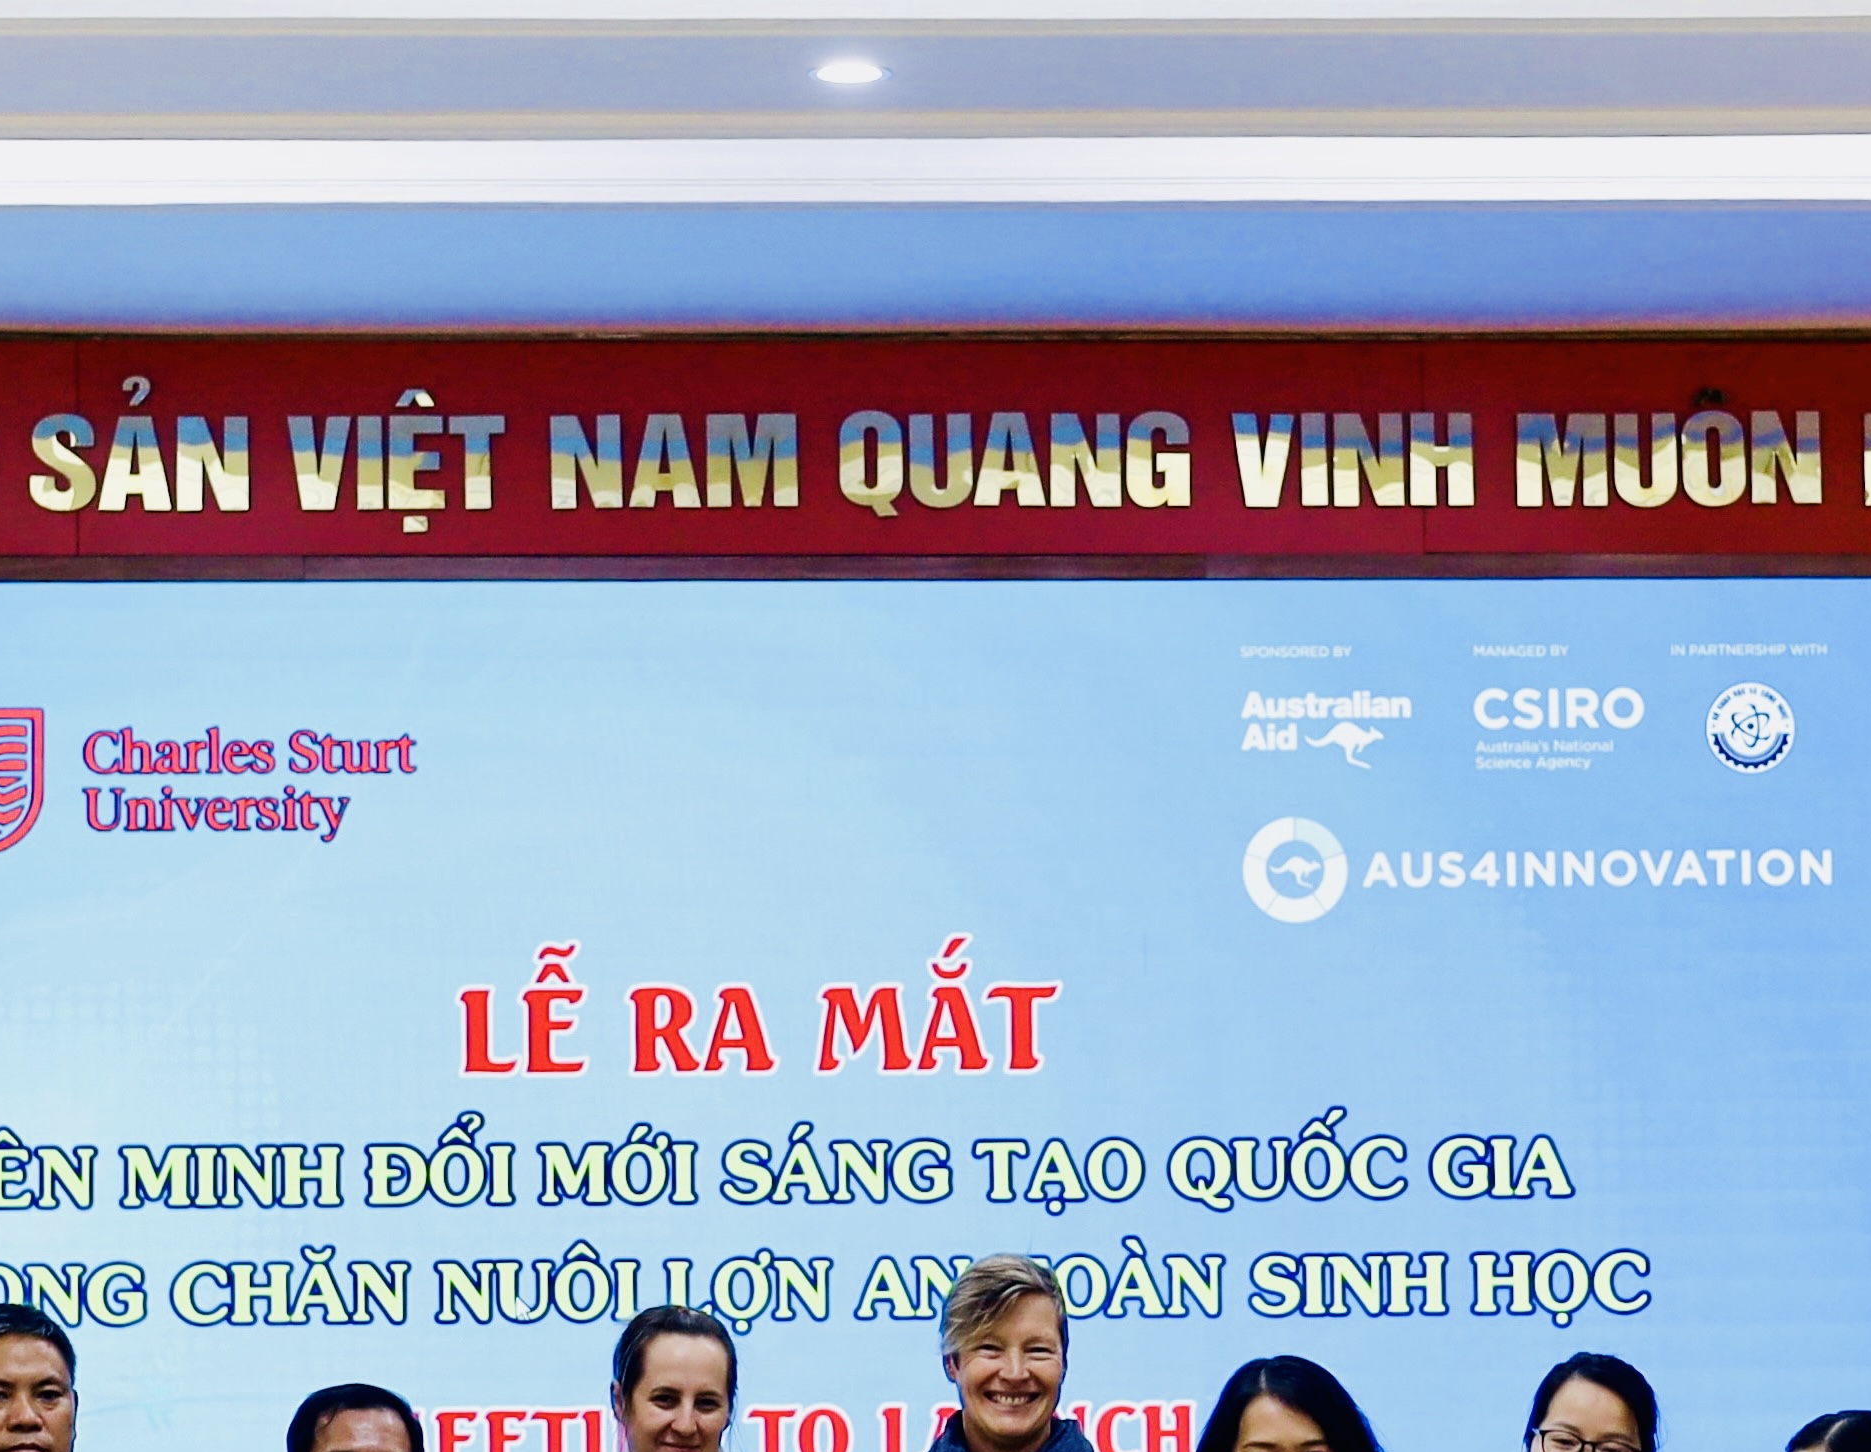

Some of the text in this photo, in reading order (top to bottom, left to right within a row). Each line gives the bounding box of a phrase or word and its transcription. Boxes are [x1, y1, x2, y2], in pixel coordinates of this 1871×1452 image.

[29, 375, 251, 515] SẢN
[288, 386, 506, 534] VIỆT
[548, 411, 798, 513] NAM
[838, 410, 1192, 517] QUANG
[1234, 412, 1473, 509] VINH
[1514, 388, 1821, 509] MUÔN
[1240, 645, 1352, 658] SPONSORED BY
[1473, 645, 1569, 658] MANAGED BY
[1670, 644, 1828, 657] IN PARTNERSHIP WITH
[1241, 690, 1412, 719] Australian
[1473, 687, 1645, 730] CSIRO
[83, 725, 418, 777] Charles Sturt
[1241, 723, 1298, 751] Aid
[1475, 739, 1614, 753] Australia's National
[1475, 756, 1591, 770] Science Agency
[83, 785, 351, 843] University
[1362, 848, 1834, 888] AUS4INNOVATION
[459, 936, 1061, 1074] LỄ RA MẮT
[119, 1143, 344, 1209] MINH
[364, 1111, 519, 1208] ĐỔI
[537, 1123, 699, 1207] MỚI
[720, 1121, 953, 1205] SÁNG
[972, 1135, 1147, 1216] TẠO
[1167, 1107, 1408, 1213] QUỐC
[1428, 1133, 1577, 1201] GIA
[168, 1244, 413, 1325] CHĂN
[436, 1240, 642, 1325] NUÔI
[663, 1247, 833, 1336] LỢN
[854, 1255, 973, 1320] AN
[1031, 1235, 1227, 1320] OÀN
[1249, 1251, 1447, 1317] SINH
[1470, 1248, 1652, 1328] HỌC
